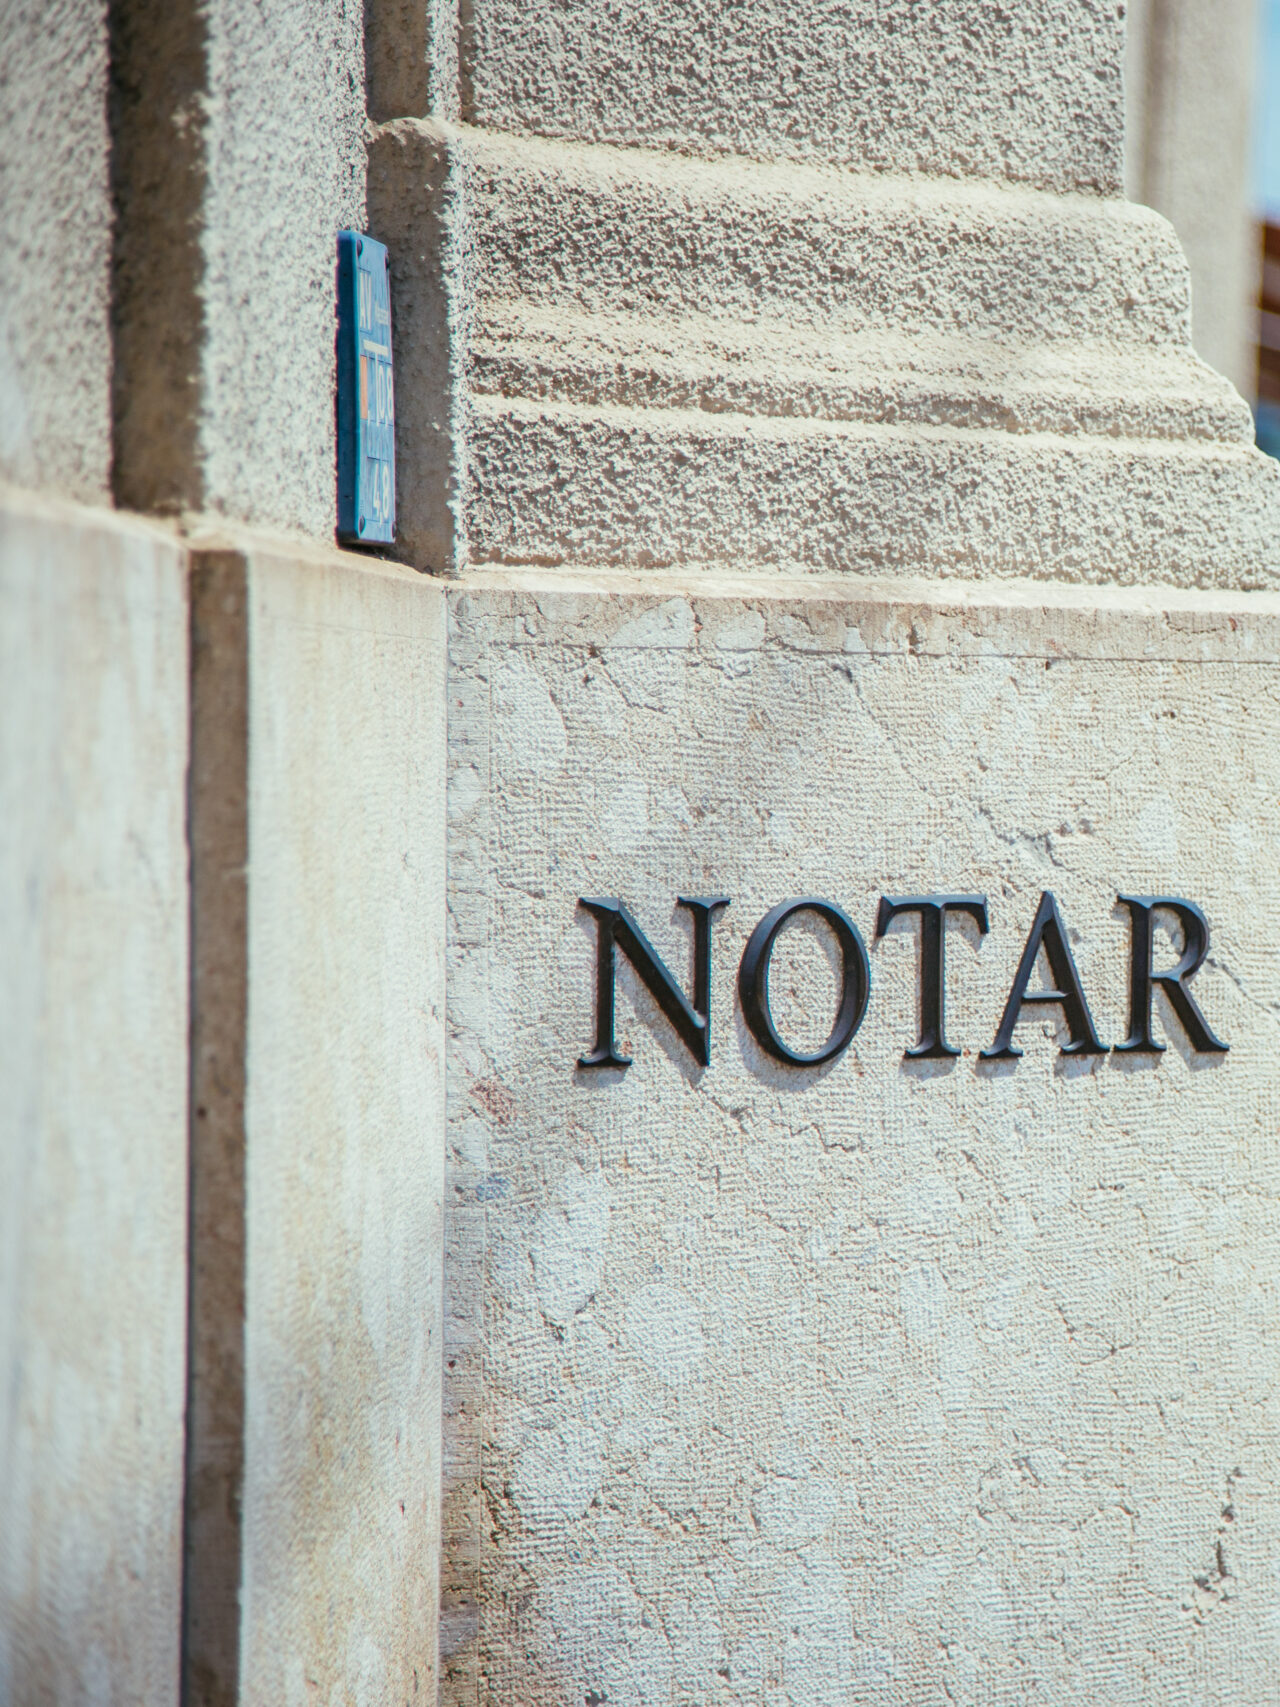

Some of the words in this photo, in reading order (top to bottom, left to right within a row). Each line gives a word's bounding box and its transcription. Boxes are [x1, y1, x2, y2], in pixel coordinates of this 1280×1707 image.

[359, 272, 372, 330] AV
[372, 464, 390, 525] 4,8
[577, 890, 1229, 1068] NOTAR
